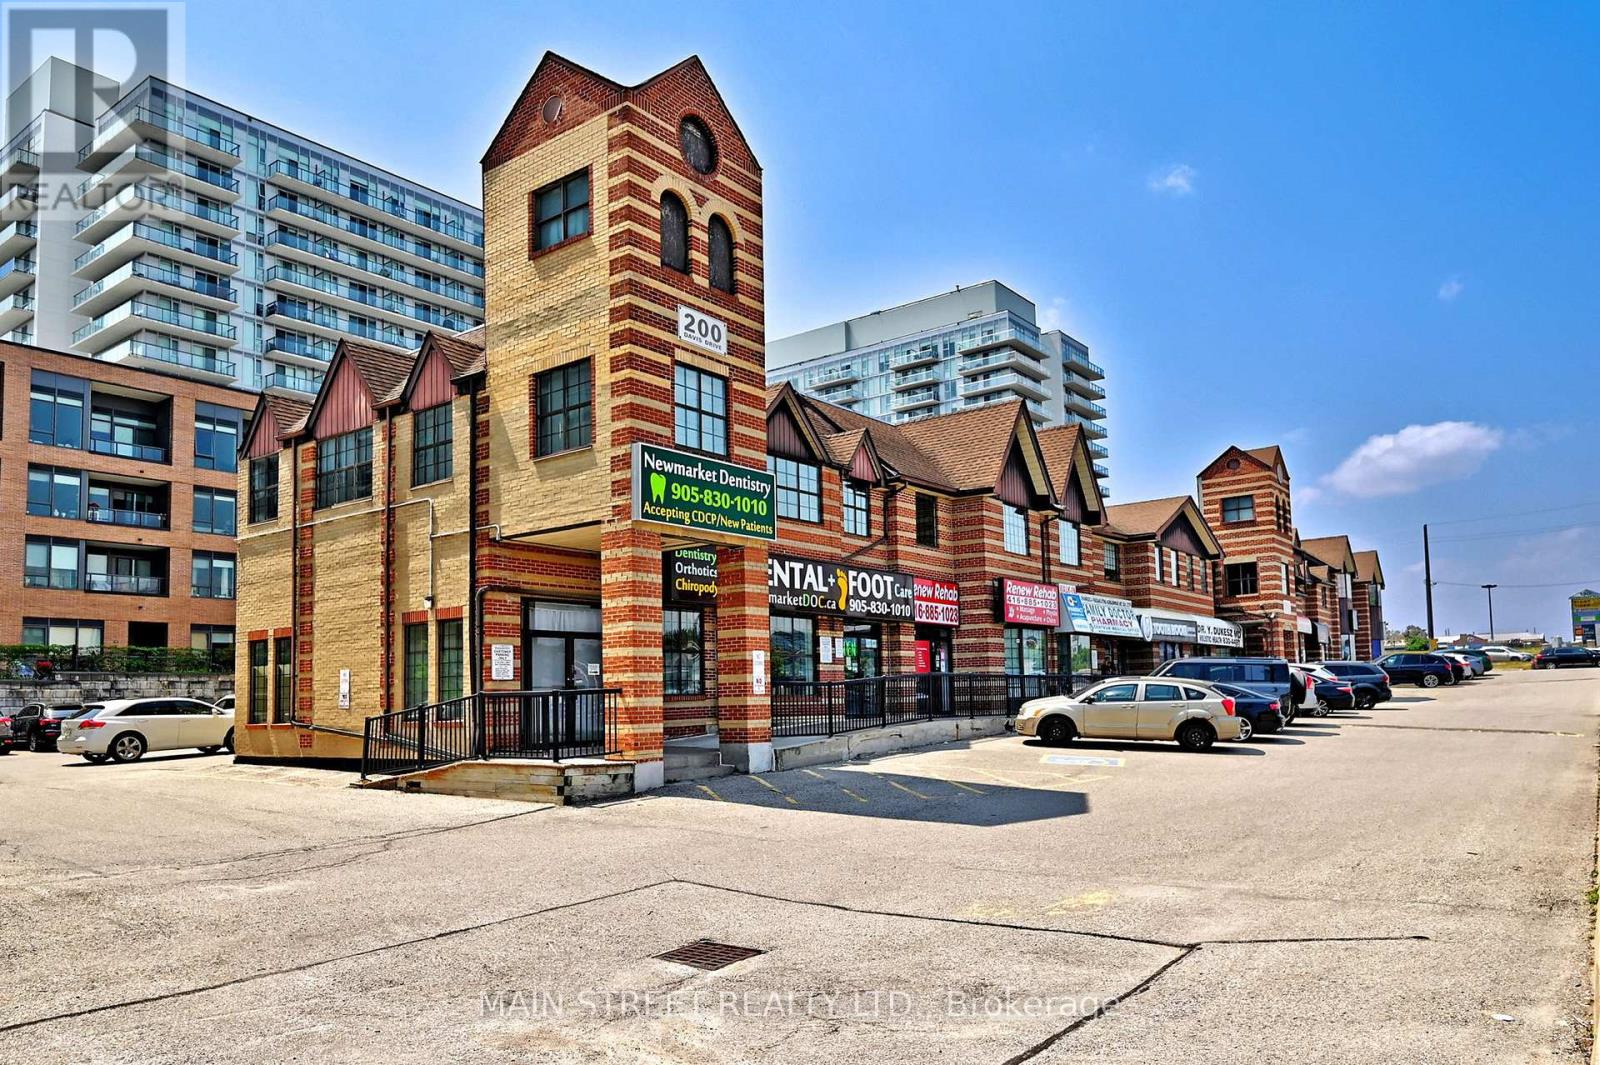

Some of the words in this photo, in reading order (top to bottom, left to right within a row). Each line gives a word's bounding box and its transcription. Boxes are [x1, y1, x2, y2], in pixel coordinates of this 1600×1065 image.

[684, 313, 722, 343] 200
[684, 332, 702, 342] DAVIS
[705, 339, 722, 350] DRIVE
[644, 452, 718, 483] Newmarket
[719, 469, 771, 499] Dentistry
[643, 501, 691, 525] Accepting
[691, 510, 740, 528] CDCP/New
[741, 518, 773, 535] Patients
[675, 549, 717, 566] Dentistry
[675, 561, 718, 578] Orthotics
[675, 577, 718, 598] Chiropody
[848, 570, 894, 600] FOOT
[894, 583, 913, 599] Care
[934, 583, 958, 602] Rehab
[1006, 581, 1033, 597] Renew
[1033, 585, 1057, 600] Rehab
[849, 601, 911, 617] 905-830-1010
[1090, 616, 1134, 628] PHARMACY
